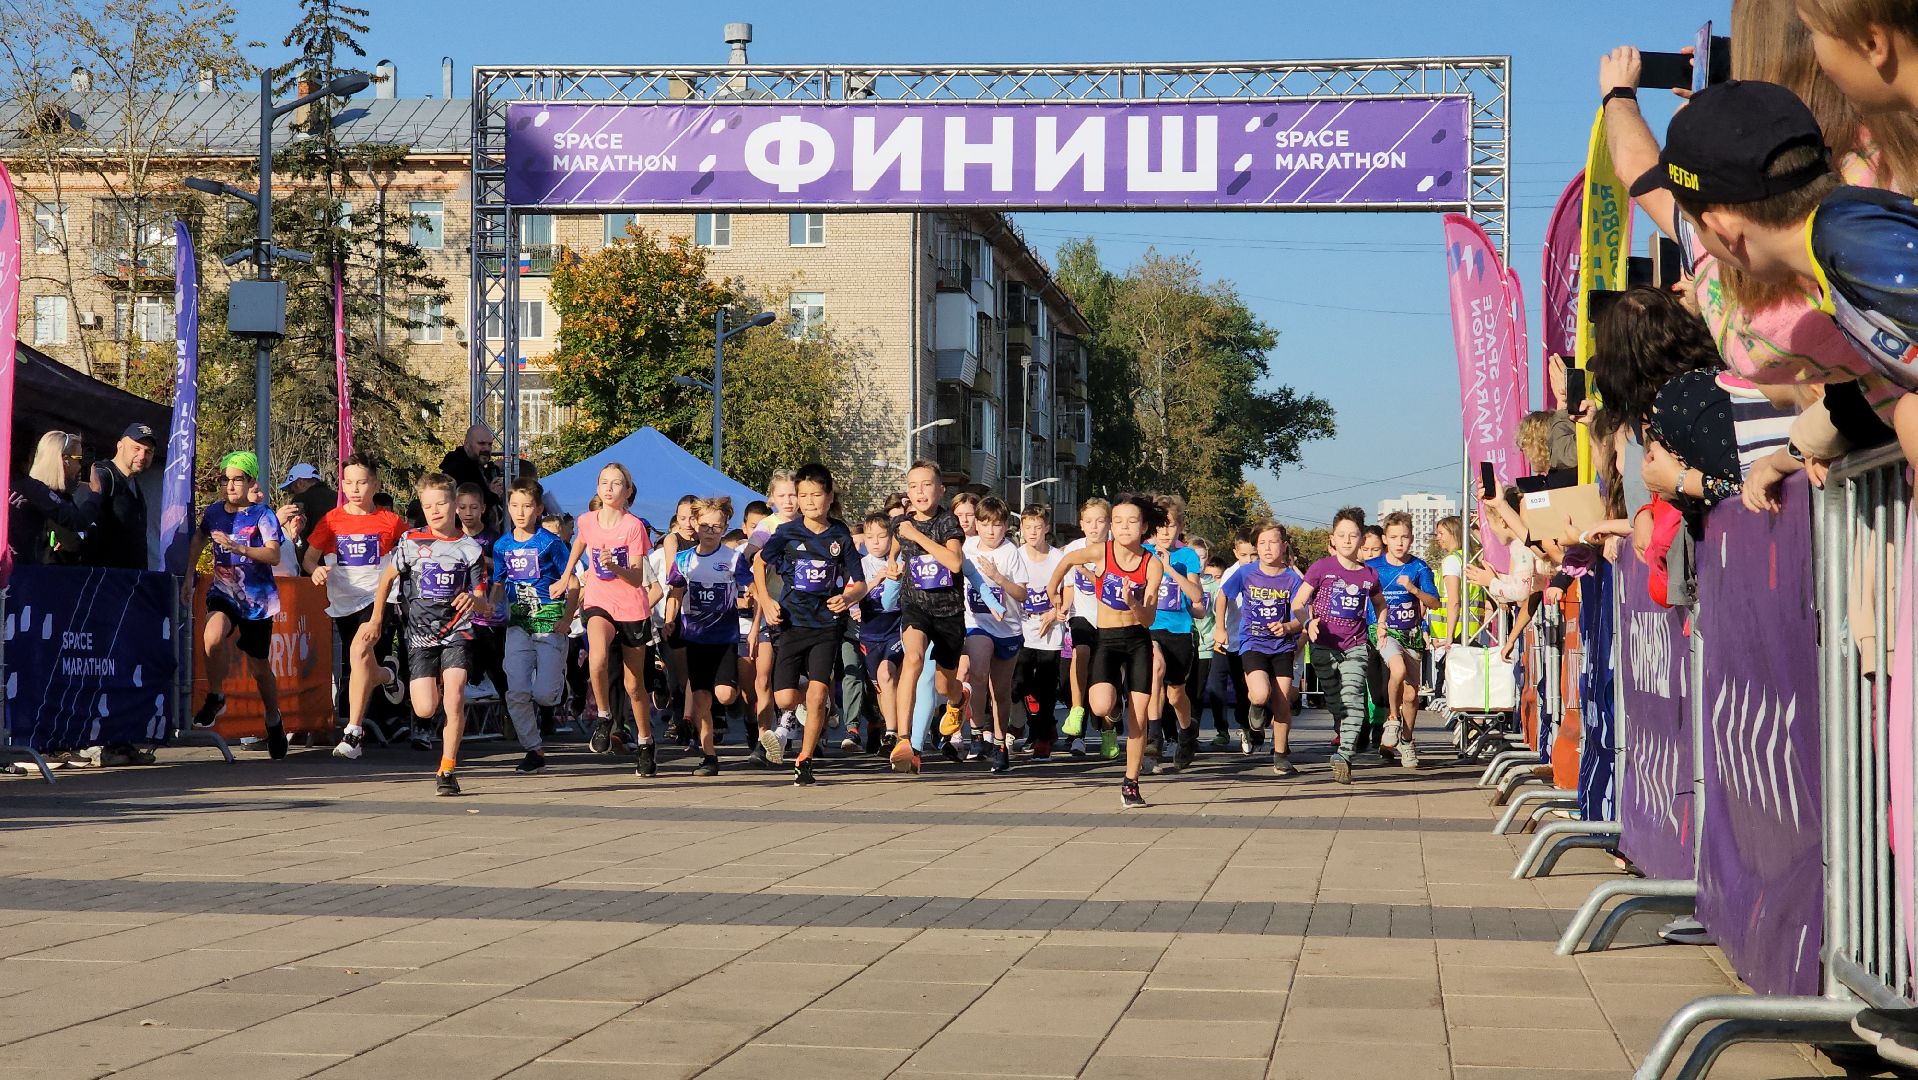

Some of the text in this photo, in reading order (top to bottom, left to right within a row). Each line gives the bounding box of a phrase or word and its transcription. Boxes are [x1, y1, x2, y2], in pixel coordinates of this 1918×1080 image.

[553, 133, 623, 149] SPACE
[1275, 130, 1349, 147] SPACE
[744, 115, 1218, 193] ФИНИШ
[1668, 163, 1700, 191] РЕГБИ
[346, 543, 367, 554] 115
[510, 558, 528, 568] 139
[805, 569, 827, 580] 134
[916, 563, 938, 577] 149
[433, 573, 455, 585] 151
[698, 590, 715, 601] 116
[1029, 592, 1049, 604] 104
[1340, 596, 1360, 607] 135
[1258, 607, 1278, 617] 132
[1396, 609, 1415, 620] 108
[62, 631, 93, 650] SPACE
